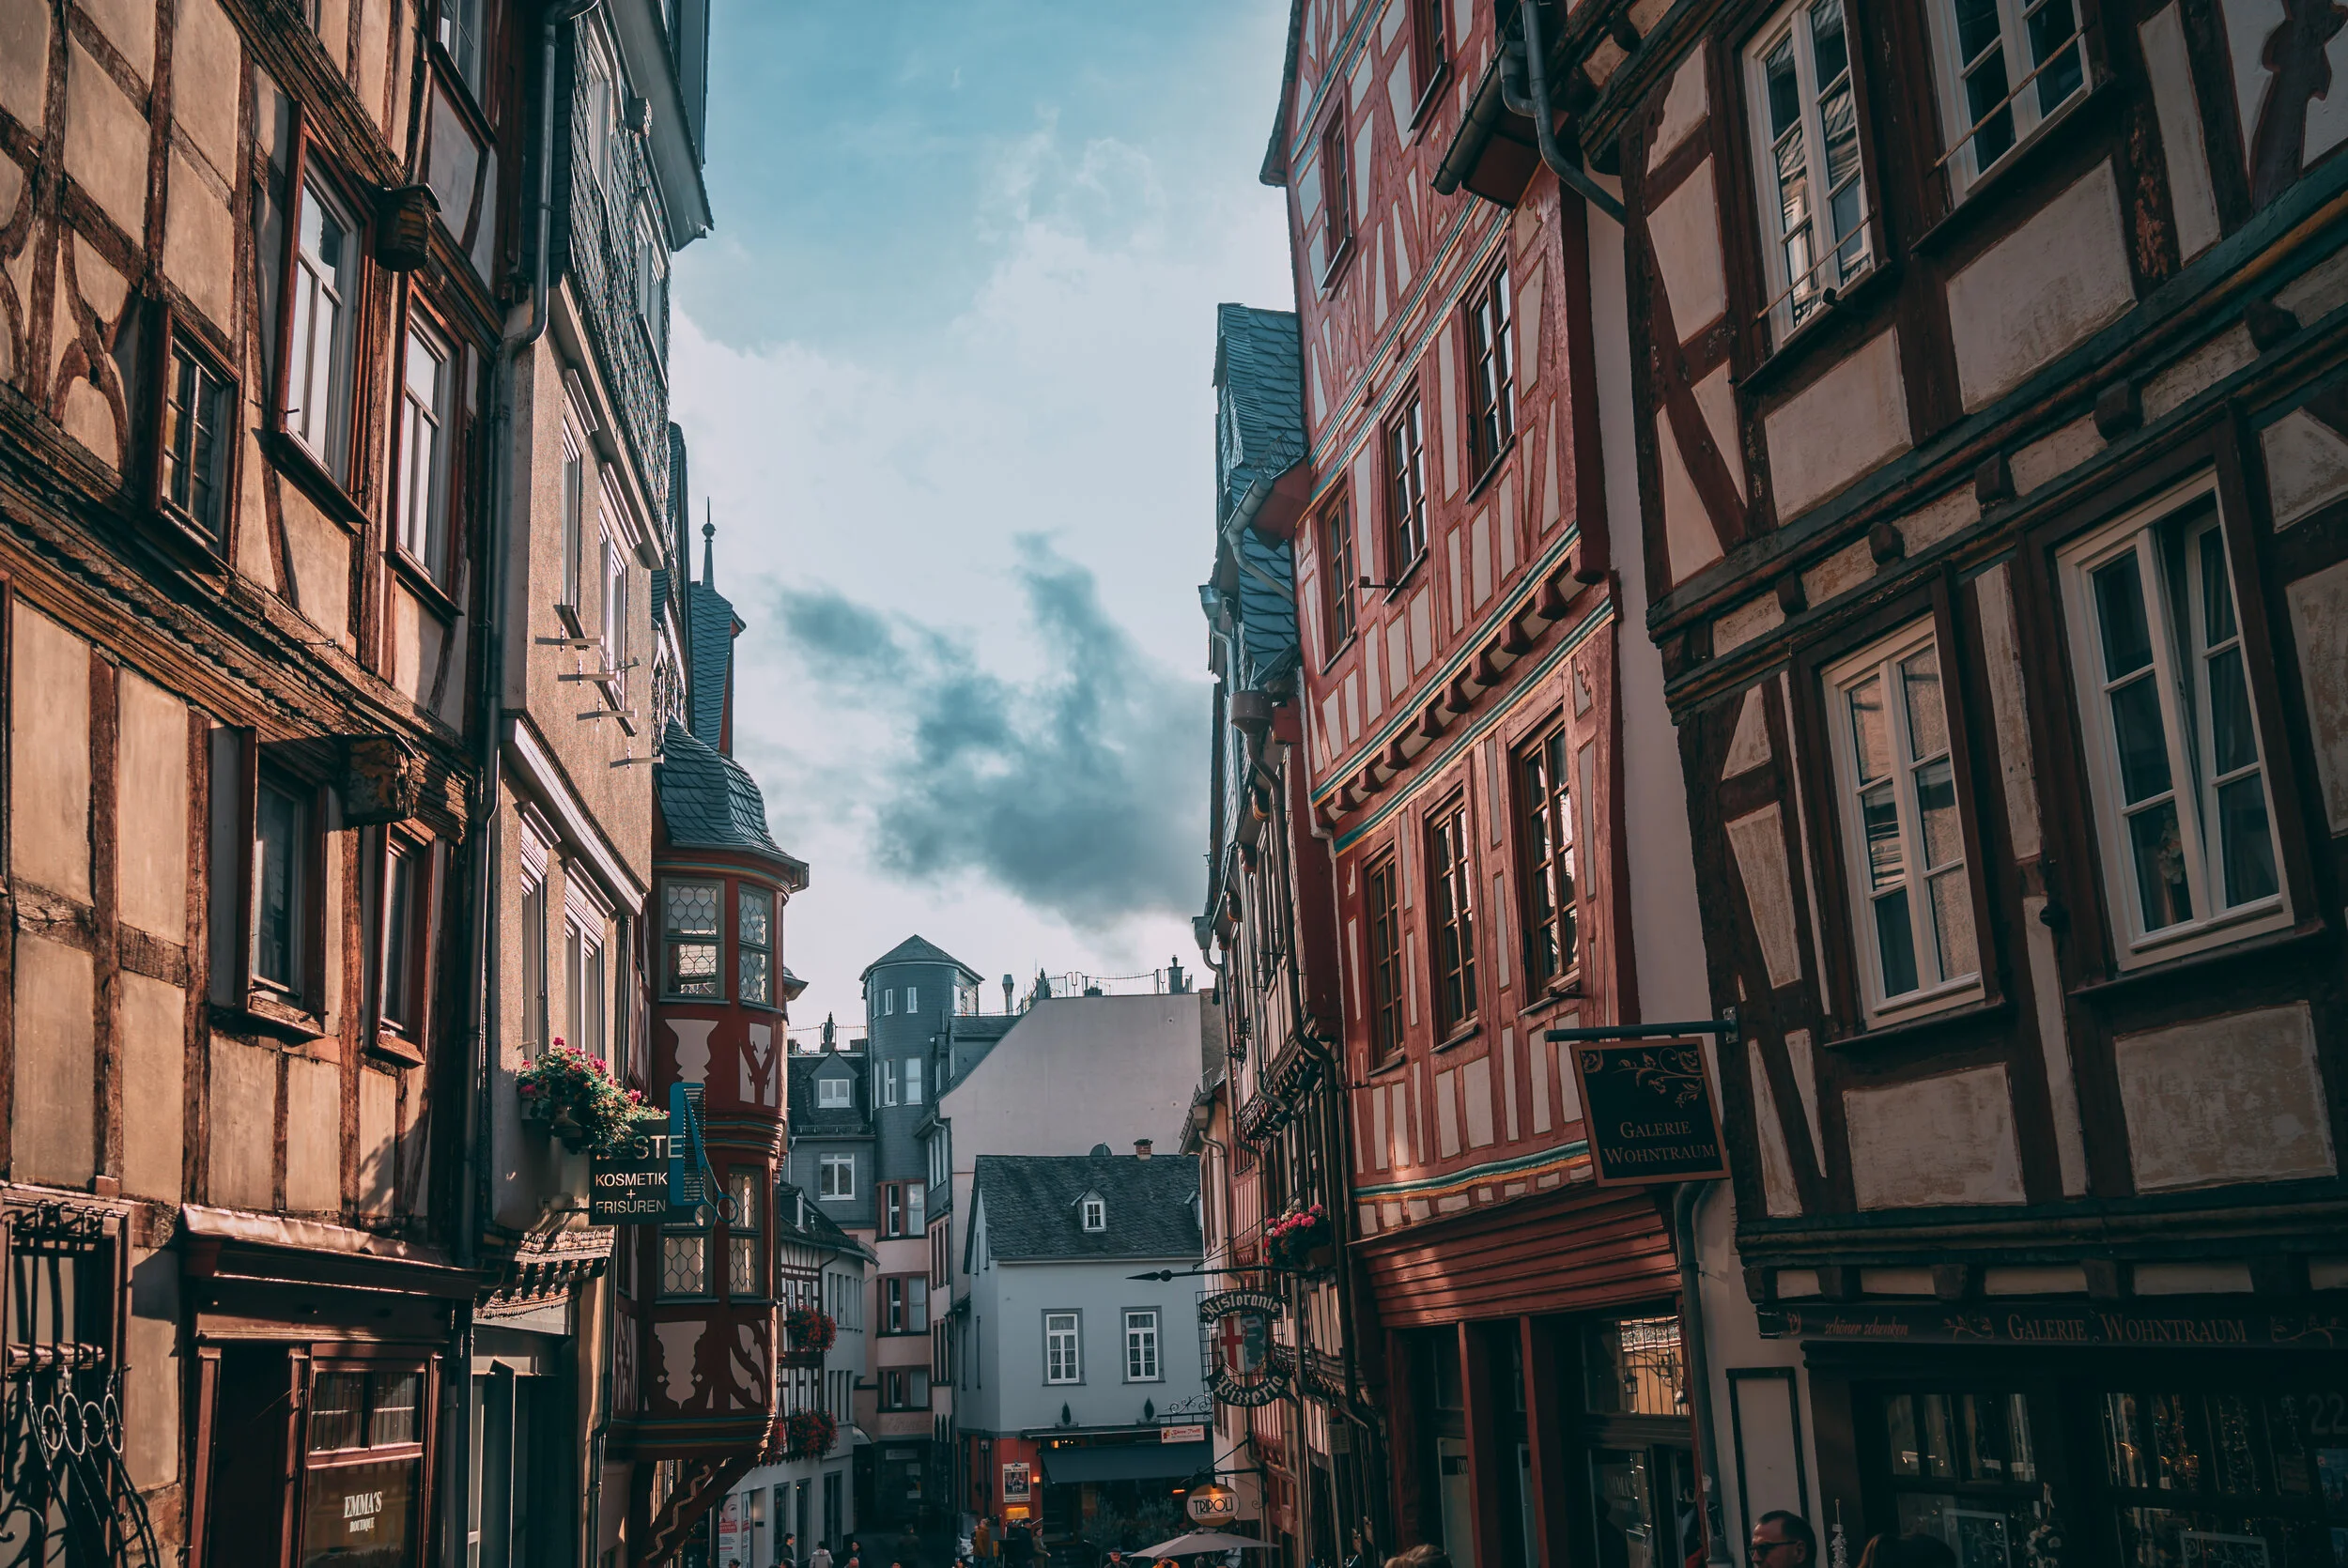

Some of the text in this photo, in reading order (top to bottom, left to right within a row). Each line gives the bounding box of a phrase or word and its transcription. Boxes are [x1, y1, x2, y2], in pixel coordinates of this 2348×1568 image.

[1619, 1121, 1691, 1139] GALERIE
[1603, 1144, 1716, 1165] WOHNTRAUM
[595, 1172, 668, 1187] KOSMETIK
[595, 1199, 666, 1215] FRISUREN
[1201, 1291, 1281, 1320] Ristorante
[1825, 1314, 1908, 1338] schöner schenken
[2007, 1313, 2248, 1344] GALERIE WOHNTRAUM
[1215, 1376, 1285, 1407] Pizzeria
[343, 1491, 383, 1518] EMMA'S
[1193, 1497, 1233, 1514] TRIPOLI
